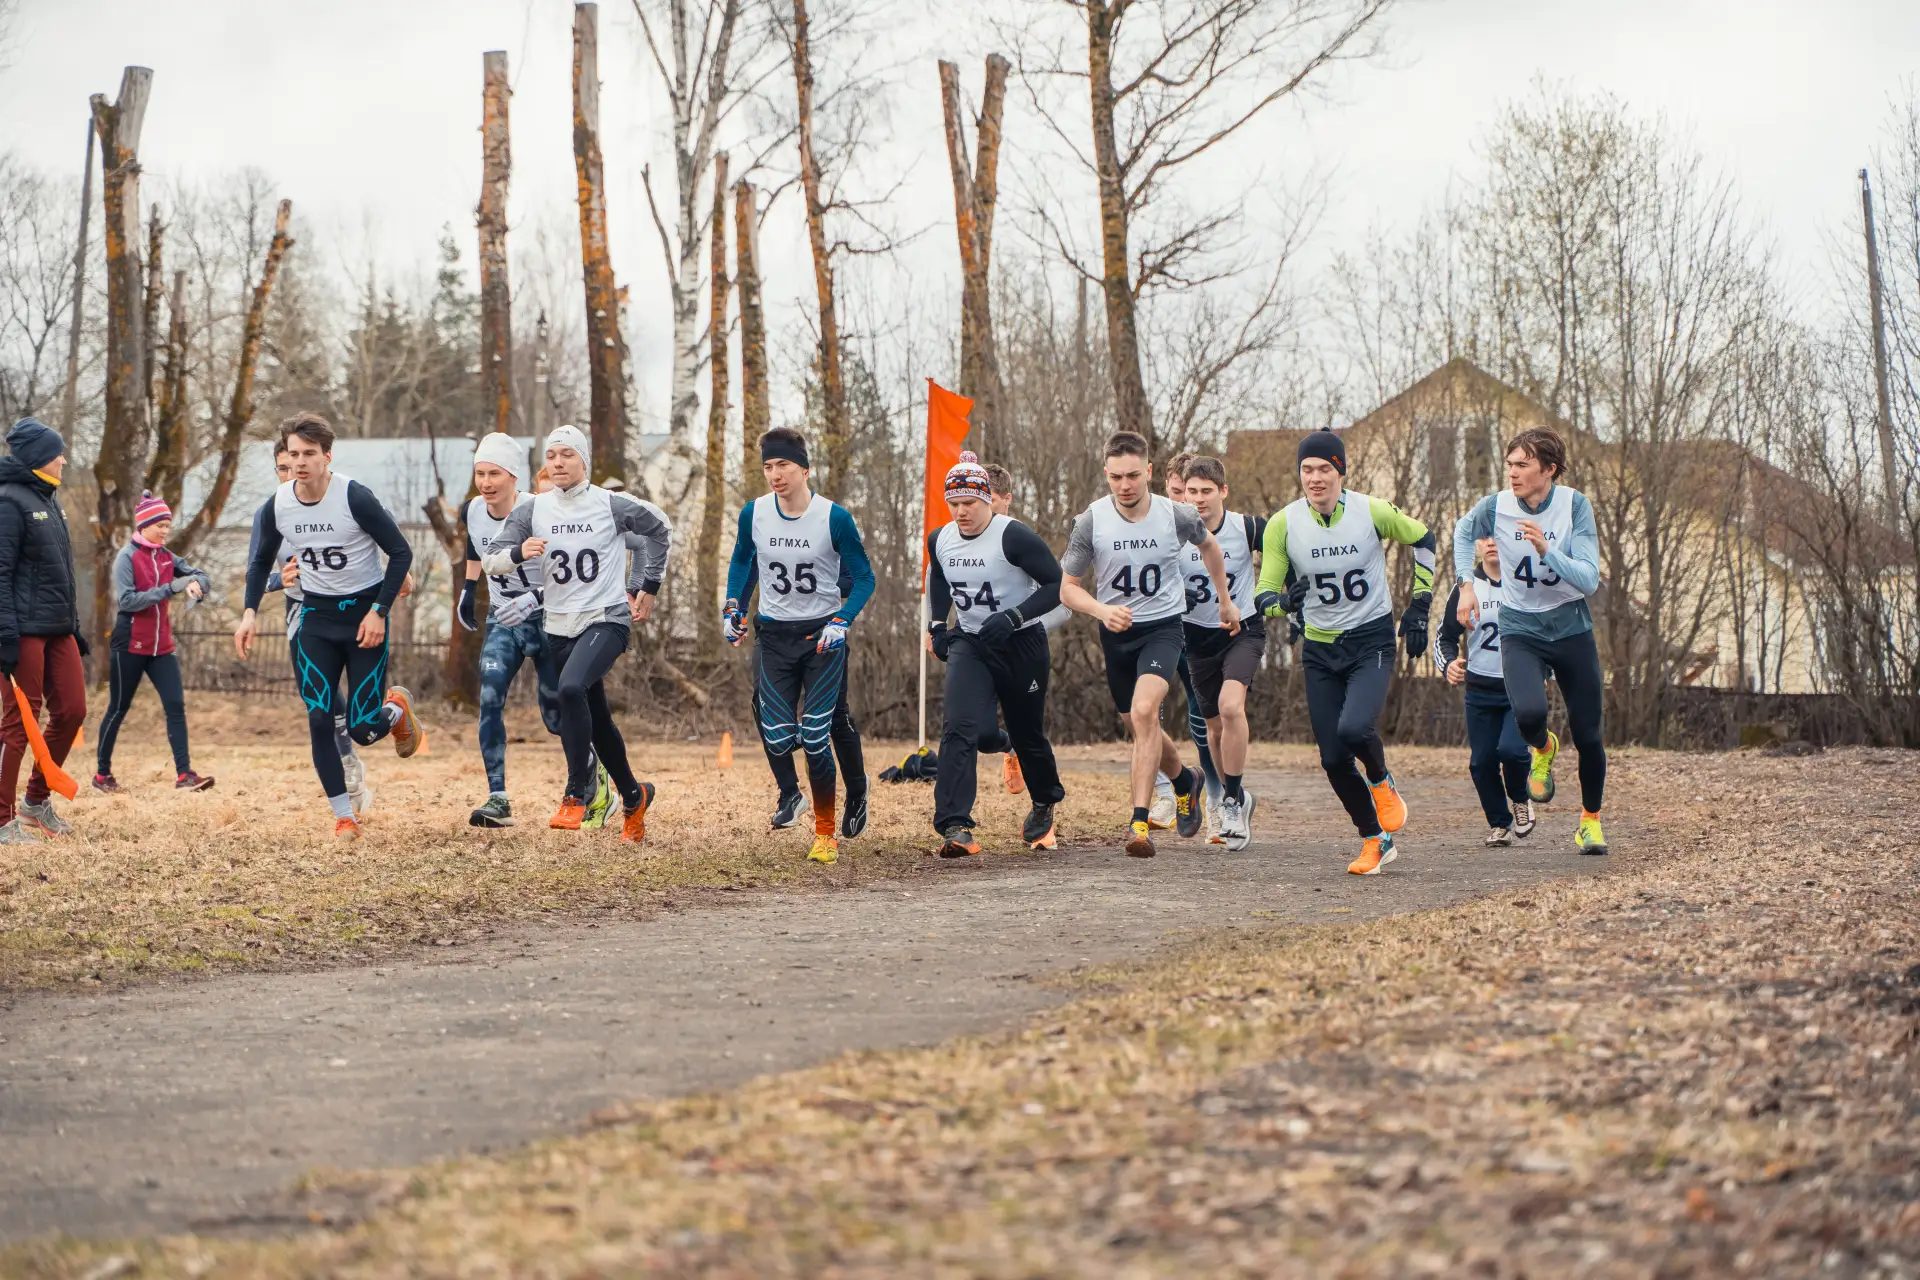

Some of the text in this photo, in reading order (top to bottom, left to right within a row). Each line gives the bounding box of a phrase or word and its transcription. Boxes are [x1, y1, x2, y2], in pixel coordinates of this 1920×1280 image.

[295, 523, 335, 534] ВГМХА
[551, 524, 593, 534] ВГМХА
[769, 537, 810, 549] ВГМХА
[1113, 538, 1158, 551] ВГМХА
[1311, 544, 1359, 558] ВГМХА
[301, 545, 348, 571] 46
[550, 548, 599, 585] 30
[949, 558, 986, 568] ВГМХА
[768, 561, 817, 596] 35
[1111, 563, 1162, 598] 40
[1314, 568, 1370, 605] 56
[950, 581, 1001, 612] 54
[1482, 600, 1503, 610] ВГМ
[1480, 621, 1499, 652] 2
